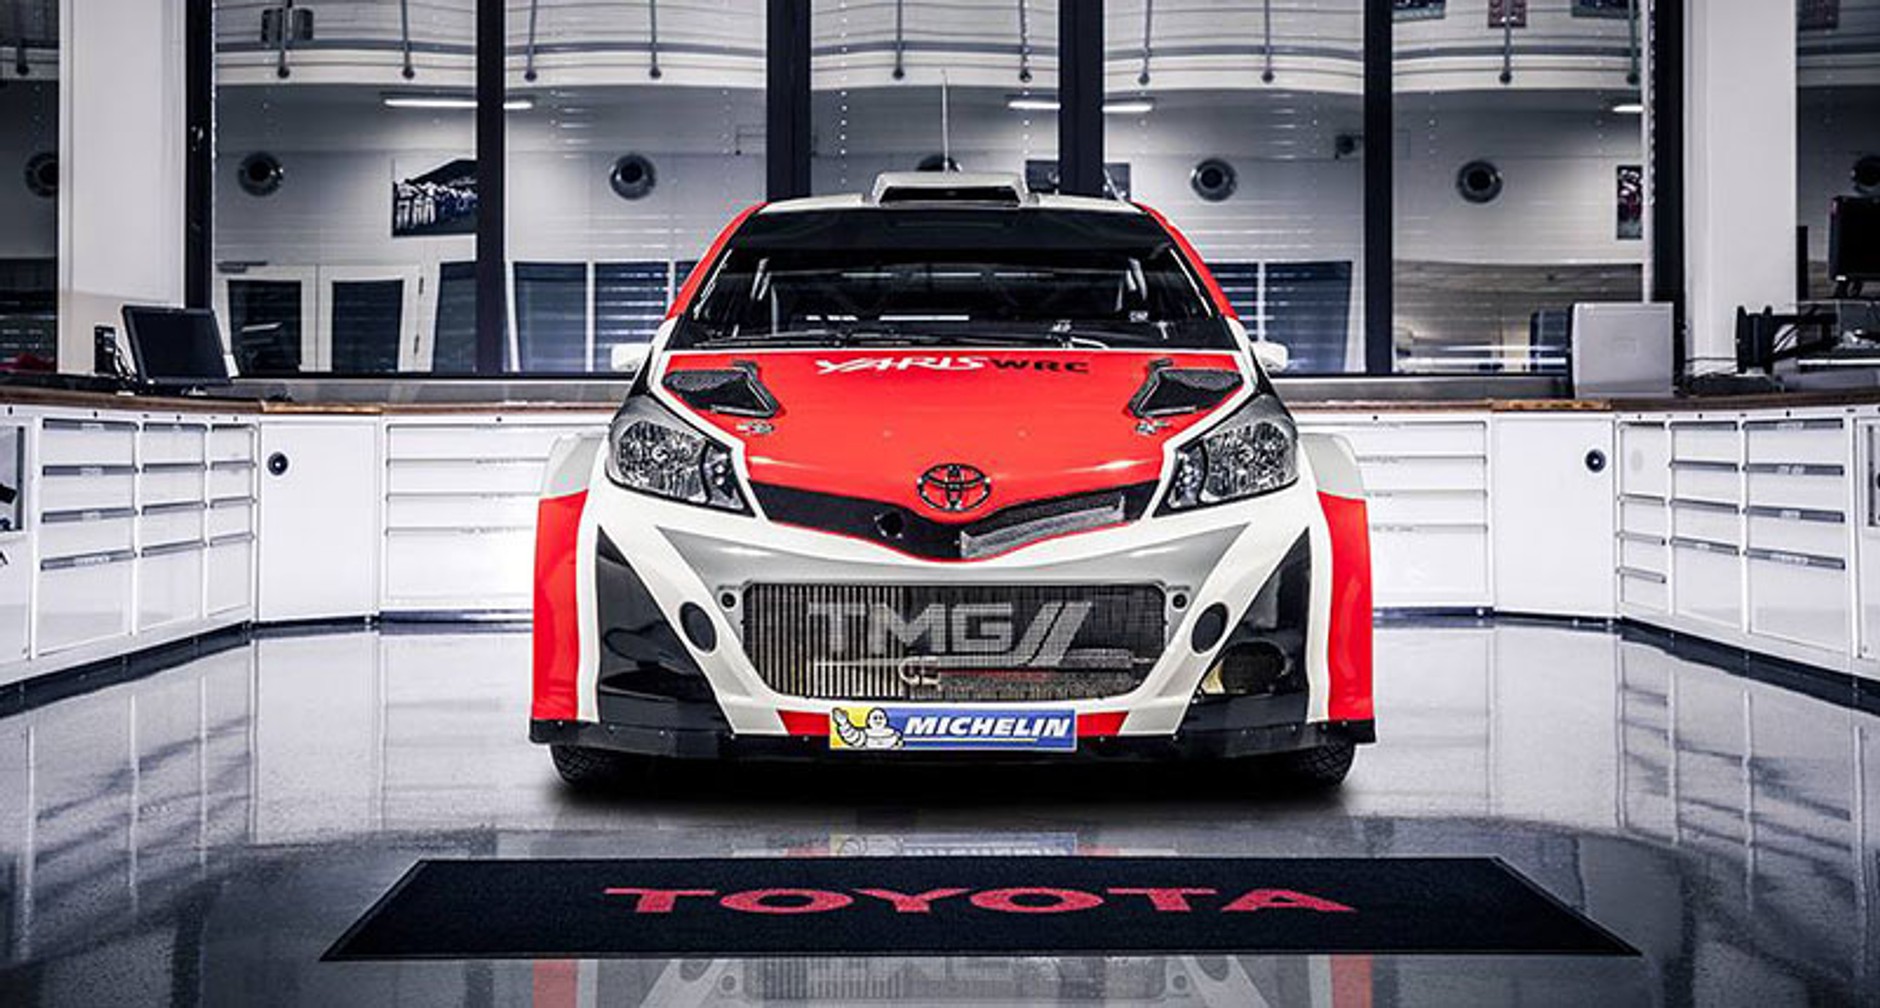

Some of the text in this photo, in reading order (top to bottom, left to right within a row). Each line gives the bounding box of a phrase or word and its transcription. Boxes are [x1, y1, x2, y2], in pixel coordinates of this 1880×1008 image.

[990, 358, 1090, 374] WRC
[807, 601, 1013, 654] TMG
[904, 716, 1072, 738] MICHELIN
[604, 887, 1358, 913] TOYOTA
